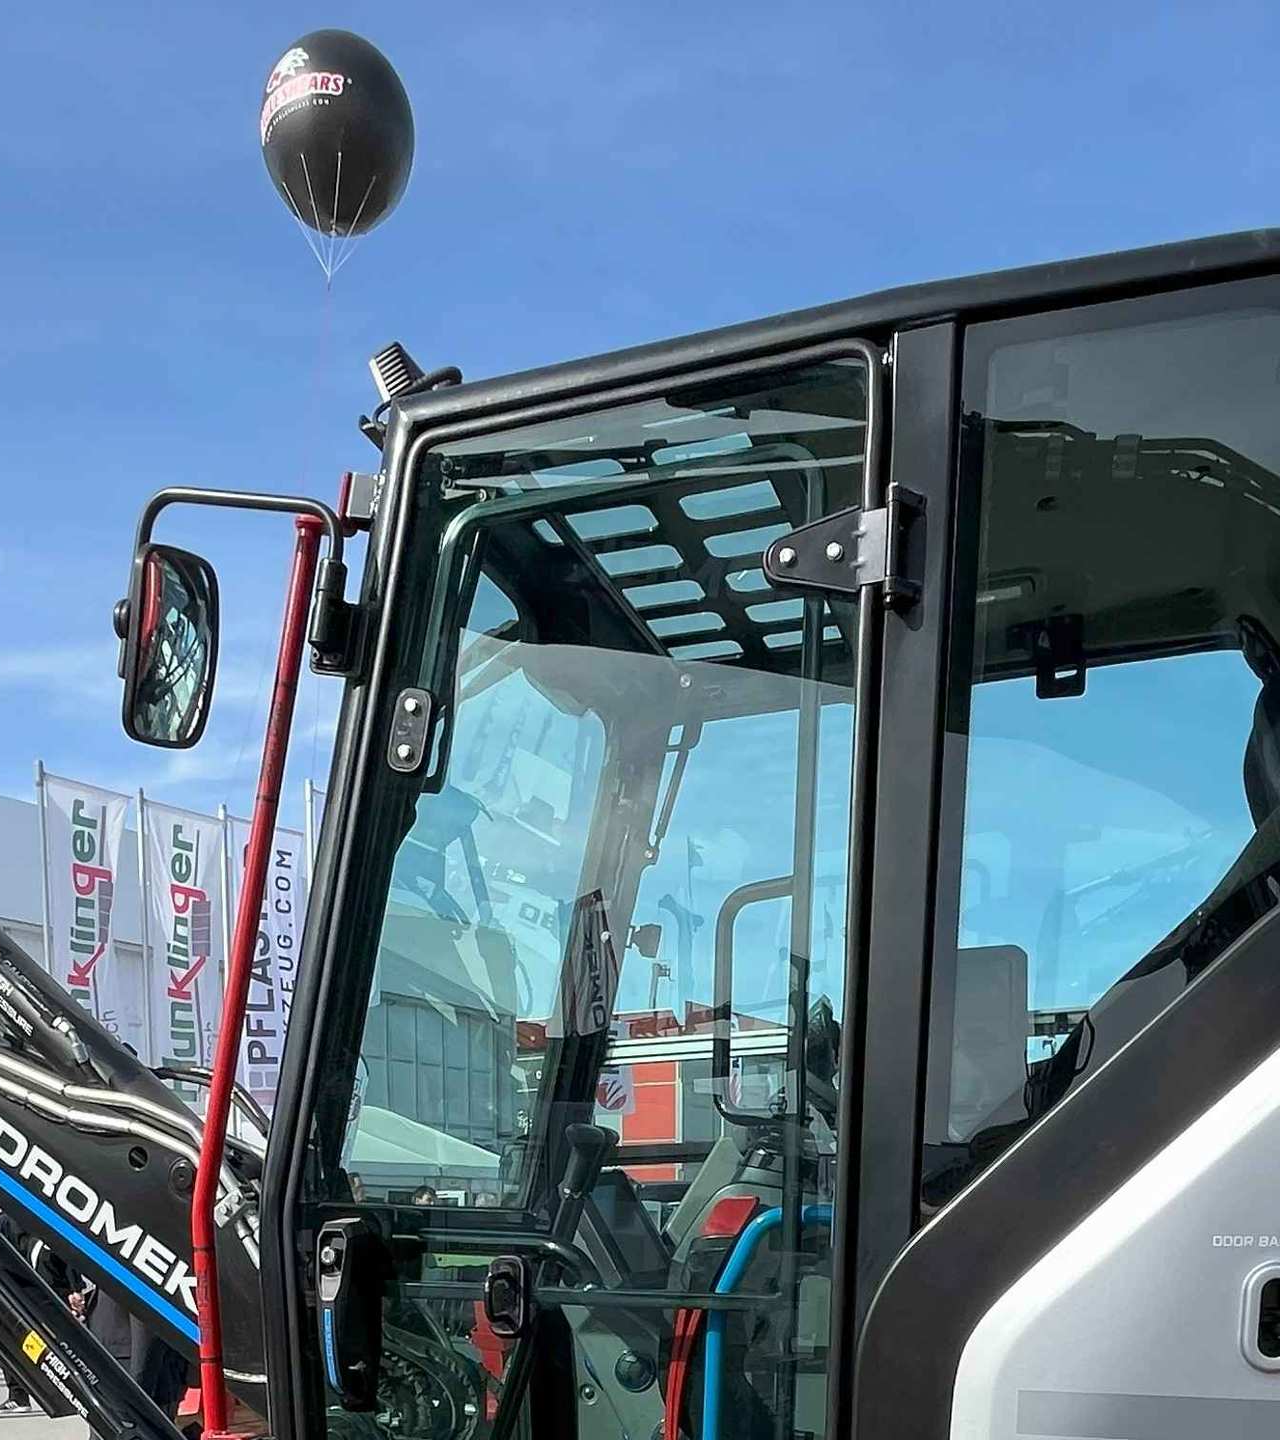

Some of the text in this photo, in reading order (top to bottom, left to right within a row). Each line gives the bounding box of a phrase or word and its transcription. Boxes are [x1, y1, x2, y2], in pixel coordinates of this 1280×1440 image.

[1212, 1235, 1254, 1248] DOOR
[45, 1350, 71, 1380] HIGH
[40, 1363, 90, 1419] PRESSURE
